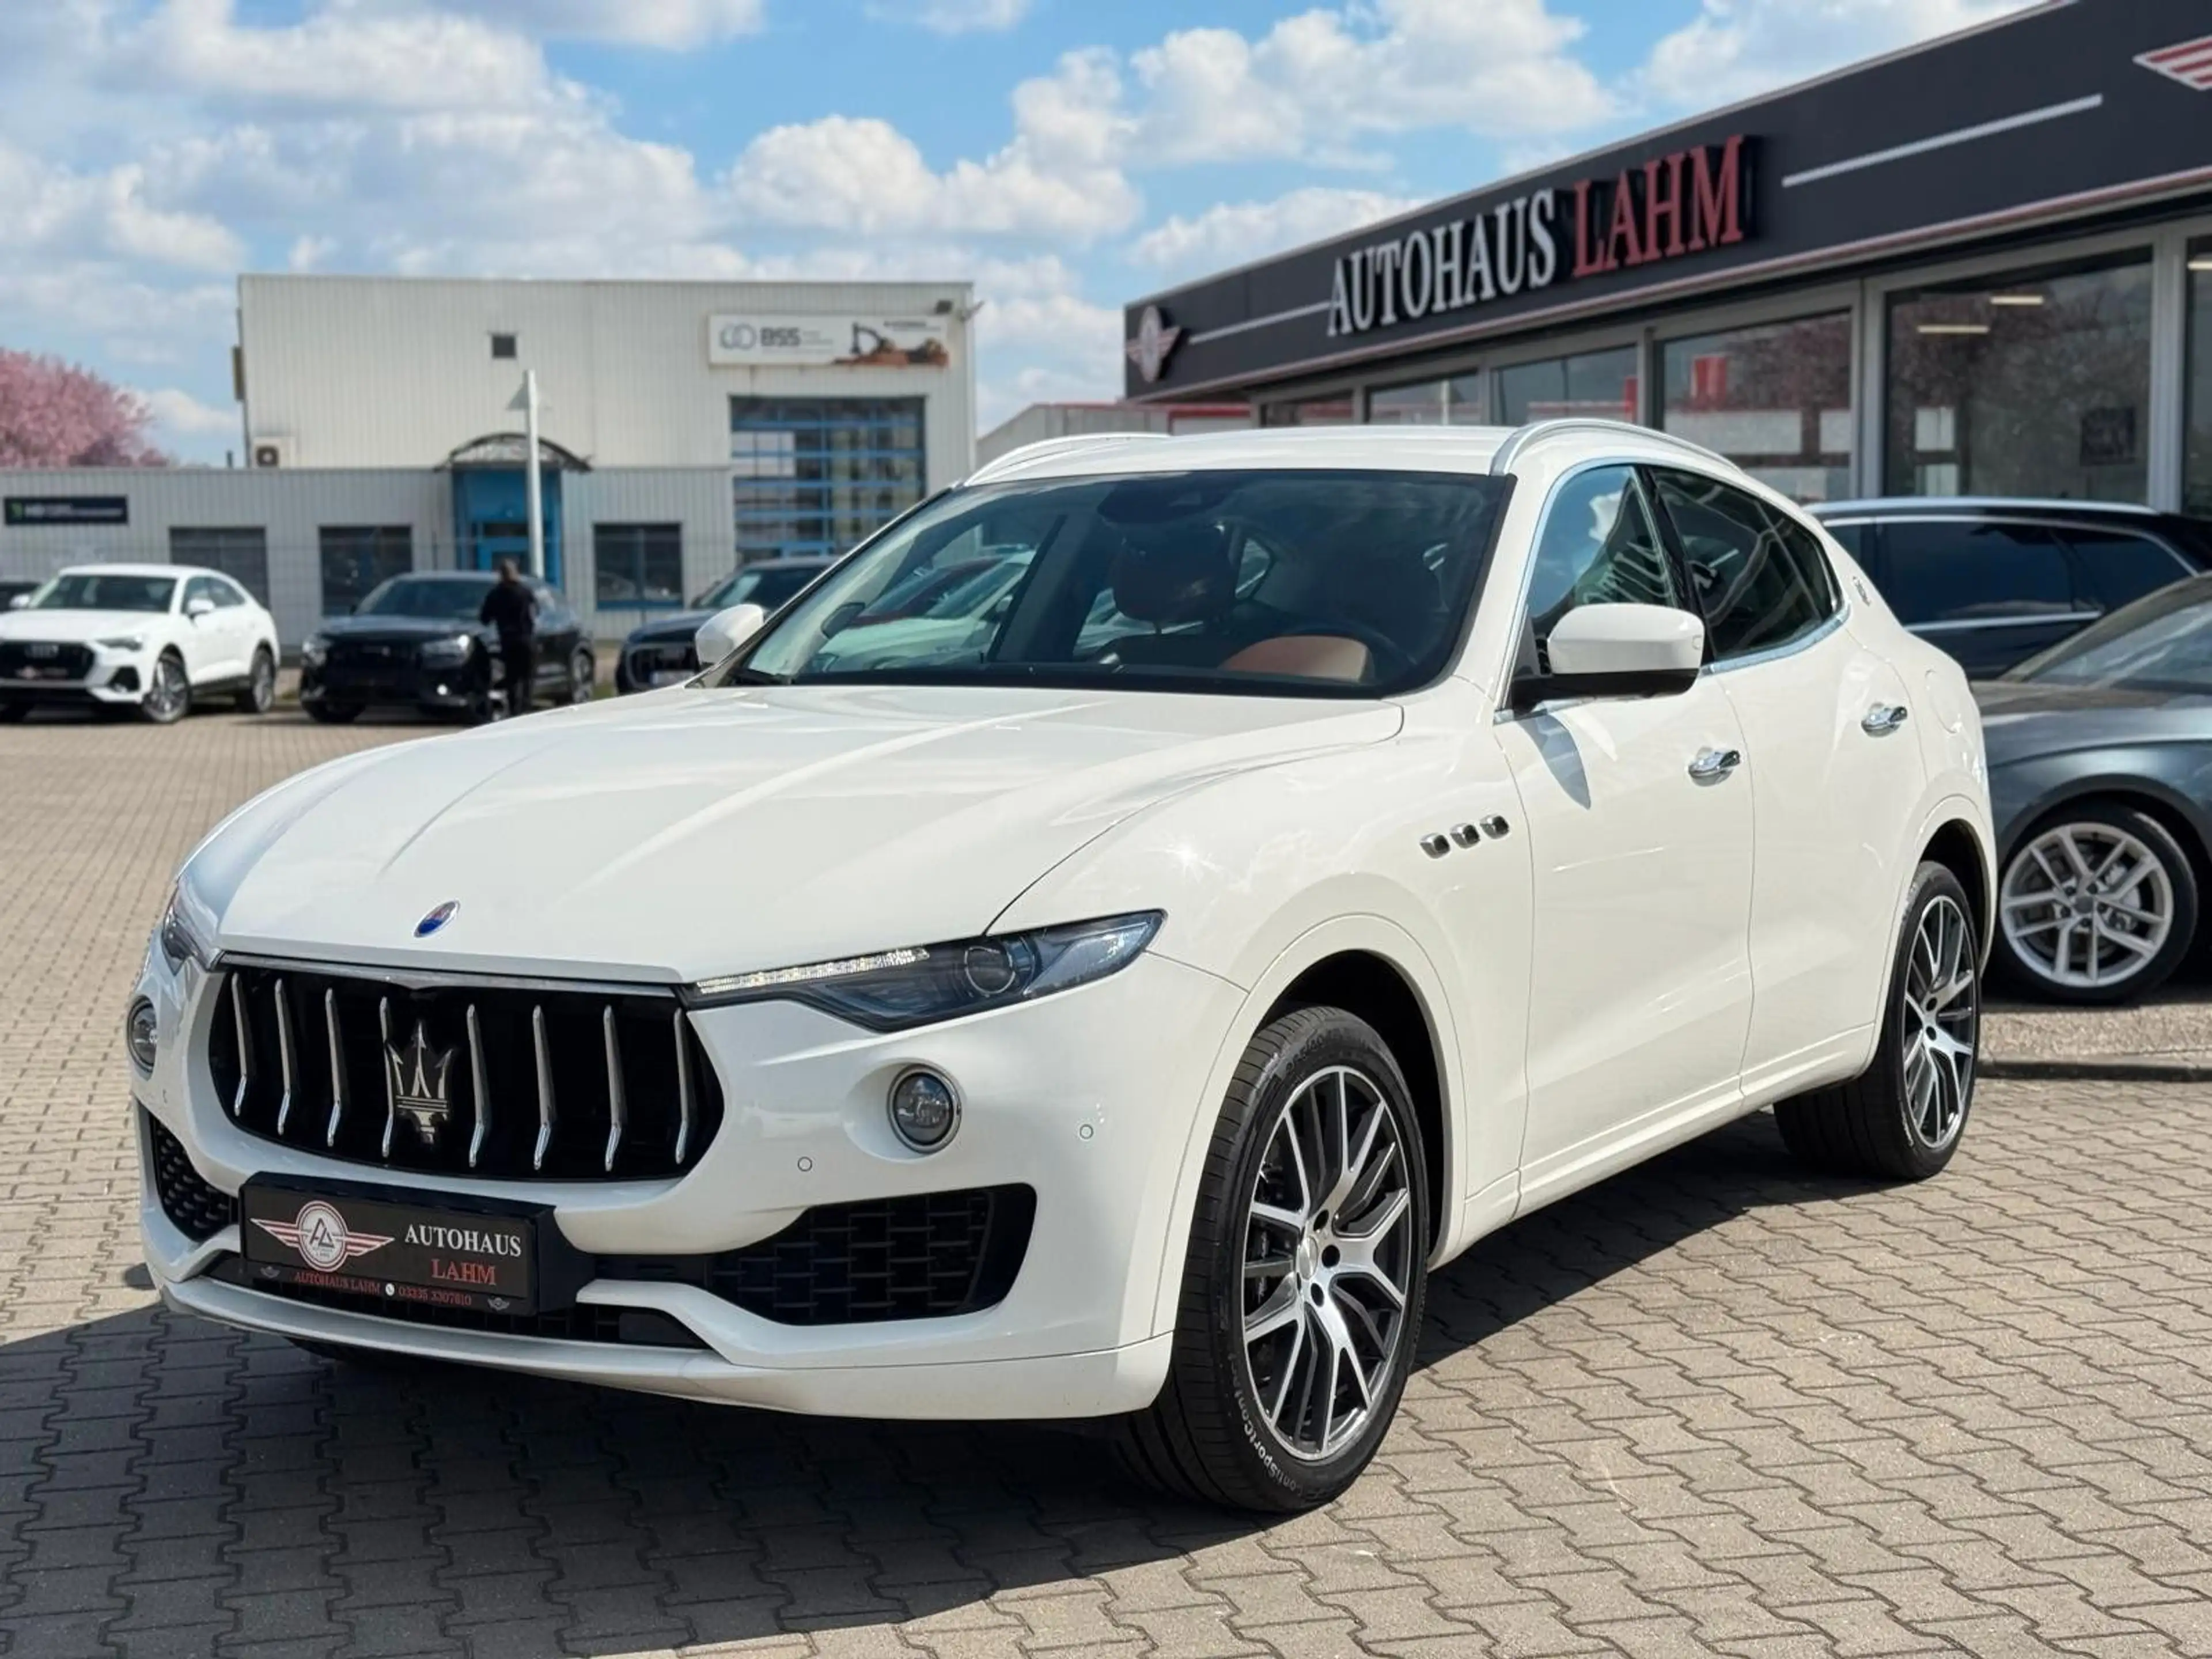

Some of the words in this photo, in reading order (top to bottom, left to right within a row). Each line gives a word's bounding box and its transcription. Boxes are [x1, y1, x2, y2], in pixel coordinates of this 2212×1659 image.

[1327, 187, 1556, 336] AUTOHAUS
[1571, 134, 1744, 278] LAHM
[404, 1224, 521, 1257] AUTOHAUS
[294, 1271, 349, 1289] AUTOHAUS
[351, 1279, 380, 1295] LAHM
[431, 1258, 496, 1285] LAHM
